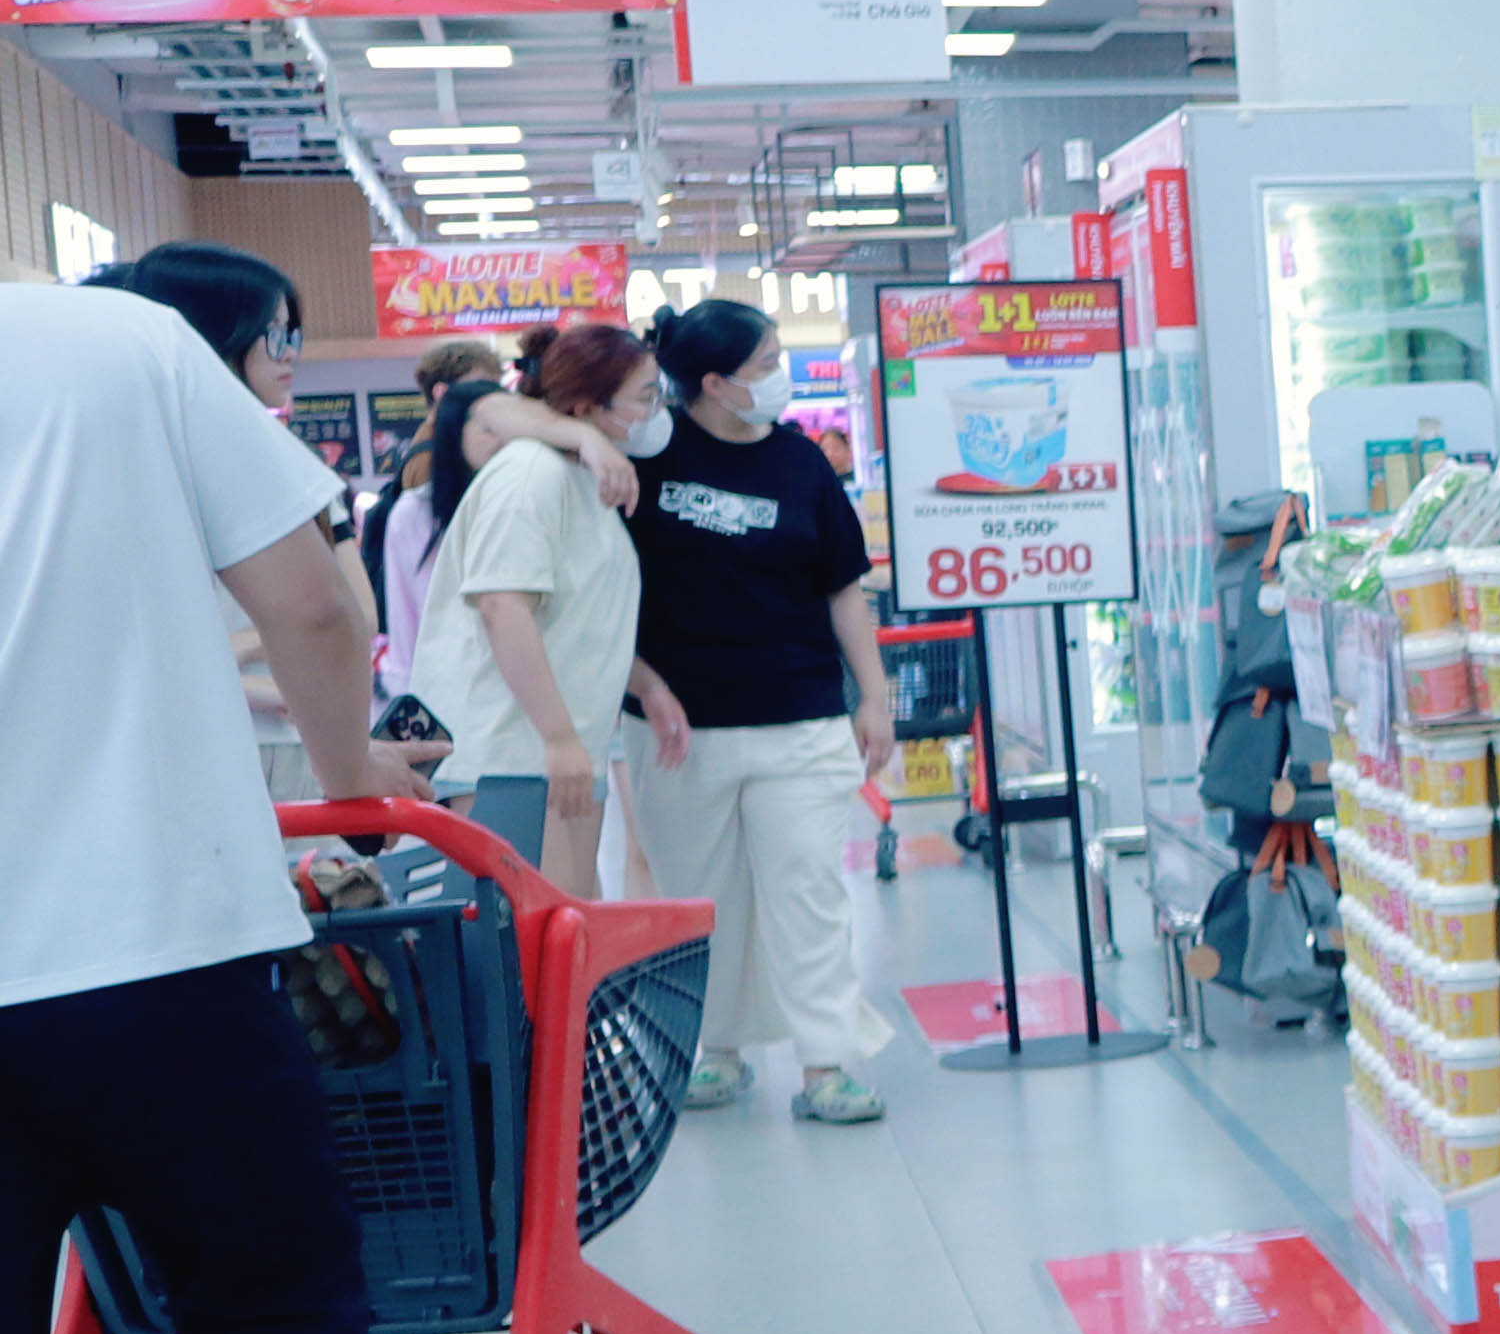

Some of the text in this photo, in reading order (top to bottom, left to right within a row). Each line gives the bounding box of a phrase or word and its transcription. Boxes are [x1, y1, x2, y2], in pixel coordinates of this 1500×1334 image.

[446, 250, 543, 281] LOTTE
[416, 280, 503, 317] MAX
[506, 276, 597, 309] SALE
[978, 292, 1037, 335] 1+1
[1058, 465, 1110, 491] 1+1
[927, 543, 1092, 599] 86,500
